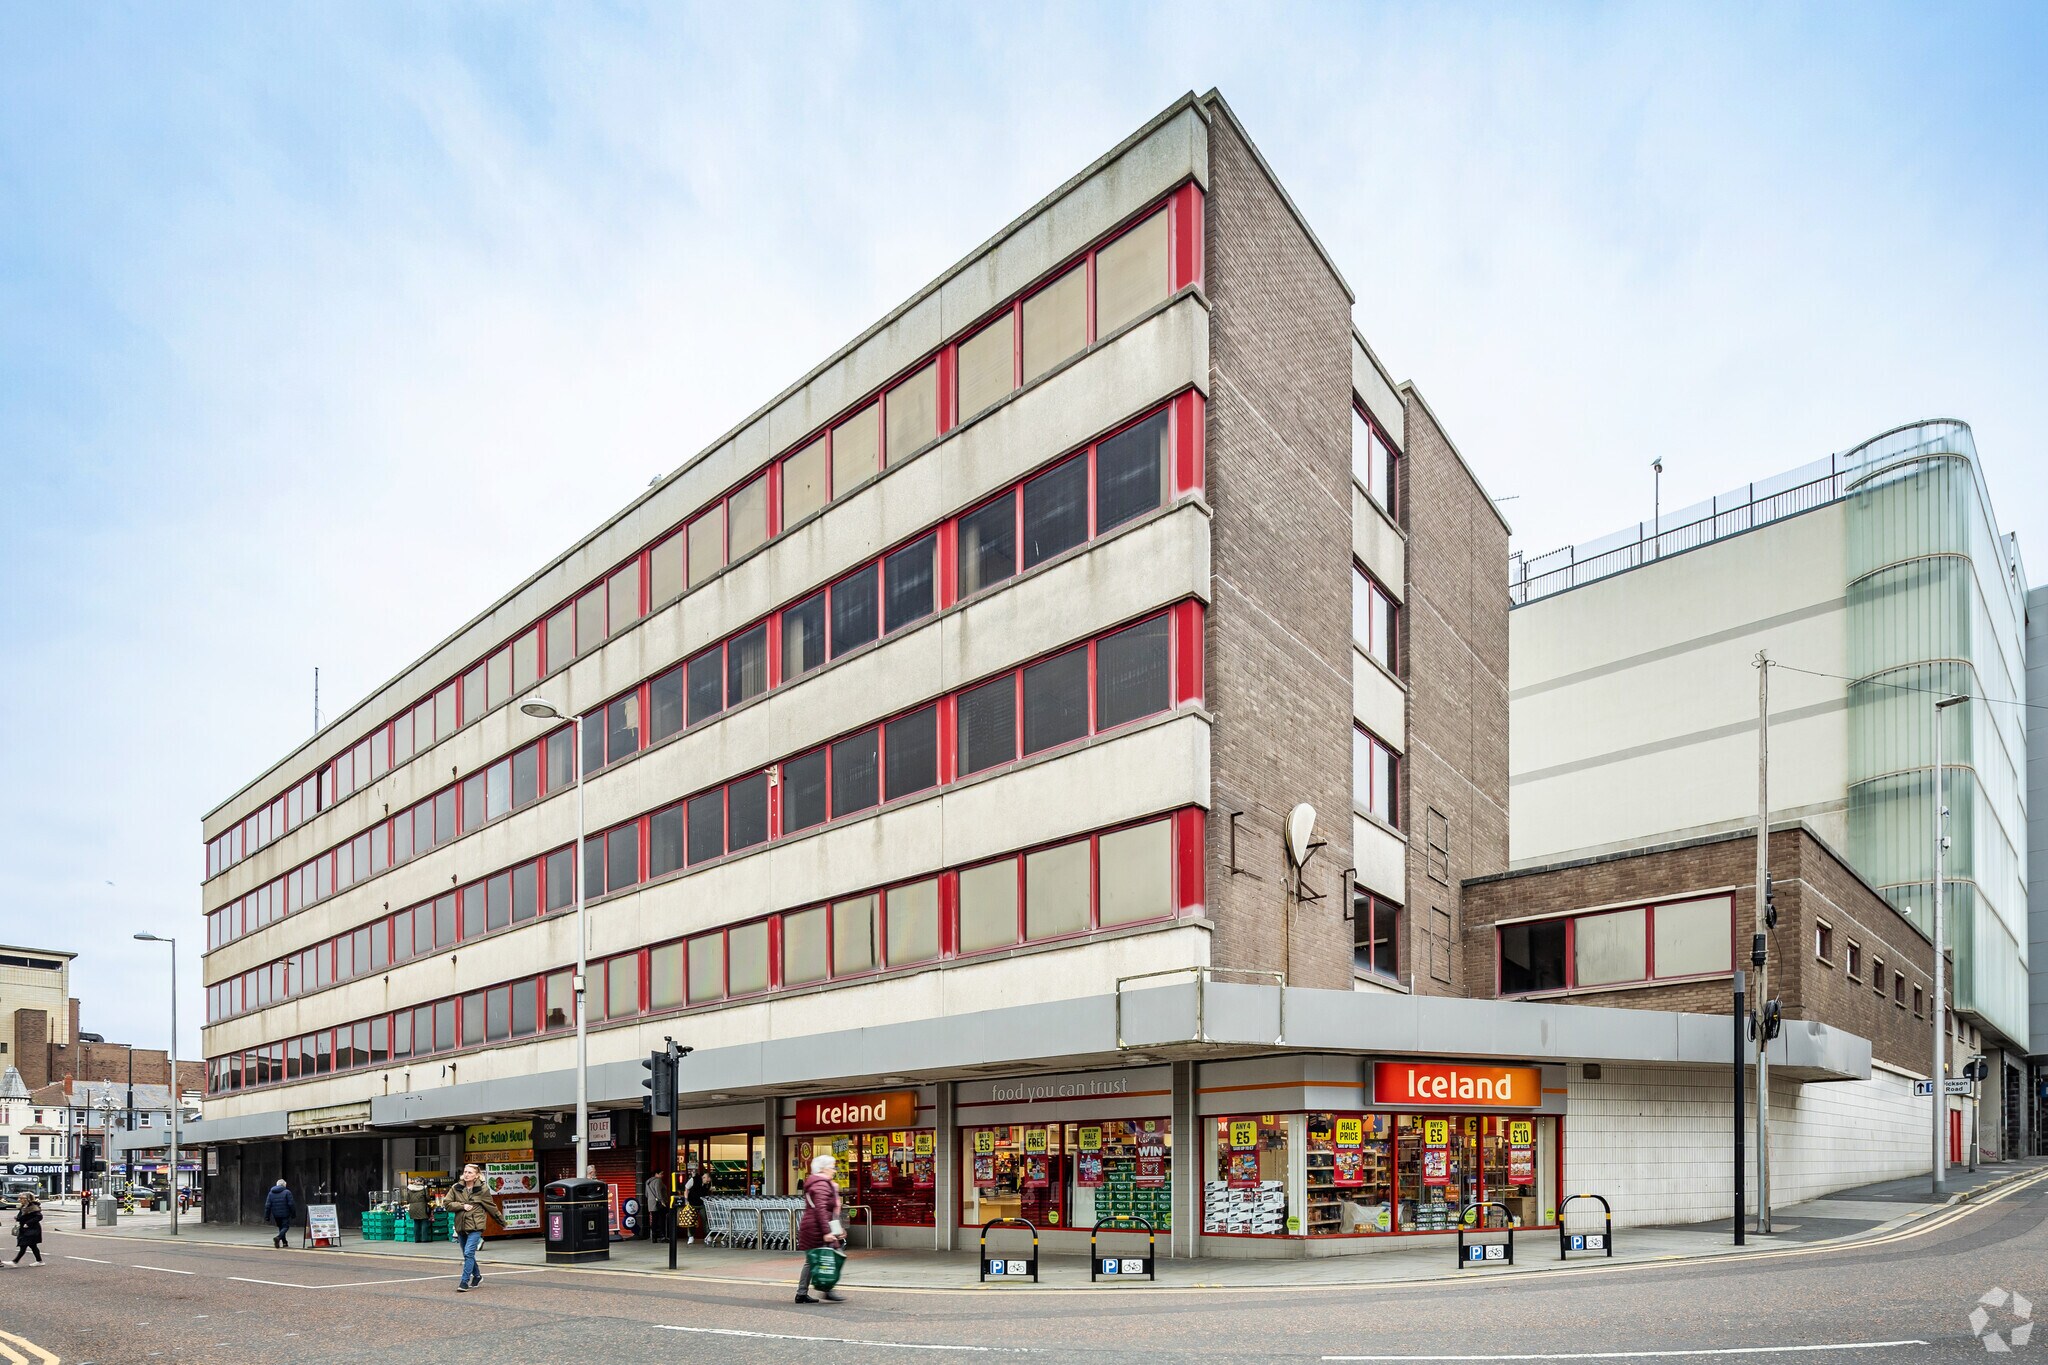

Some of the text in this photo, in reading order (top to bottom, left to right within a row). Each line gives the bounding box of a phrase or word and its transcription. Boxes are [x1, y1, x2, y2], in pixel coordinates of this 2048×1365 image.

[992, 1077, 1127, 1103] food you can trust
[1408, 1069, 1512, 1100] Iceland
[816, 1099, 886, 1125] Iceland
[590, 1121, 609, 1132] TO LET
[1247, 1122, 1251, 1130] 4
[1341, 1122, 1357, 1130] HALF
[477, 1128, 526, 1144] The Salad Bowl
[1084, 1132, 1097, 1140] HALF
[1236, 1131, 1250, 1145] £5
[1340, 1132, 1358, 1140] PRICE
[1430, 1129, 1443, 1143] £5
[1512, 1129, 1529, 1143] £10
[979, 1139, 990, 1151] £5
[1028, 1137, 1044, 1148] FREE
[1083, 1140, 1097, 1148] PRICE
[875, 1143, 884, 1154] £5
[1138, 1146, 1163, 1157] WIN
[465, 1152, 510, 1162] CATERING SUPPLIES
[28, 1165, 69, 1173] THE CATCH
[501, 1163, 519, 1171] Salad
[1573, 1236, 1582, 1248] P
[1472, 1246, 1481, 1259] P
[992, 1260, 1003, 1274] P
[1105, 1259, 1116, 1272] P
